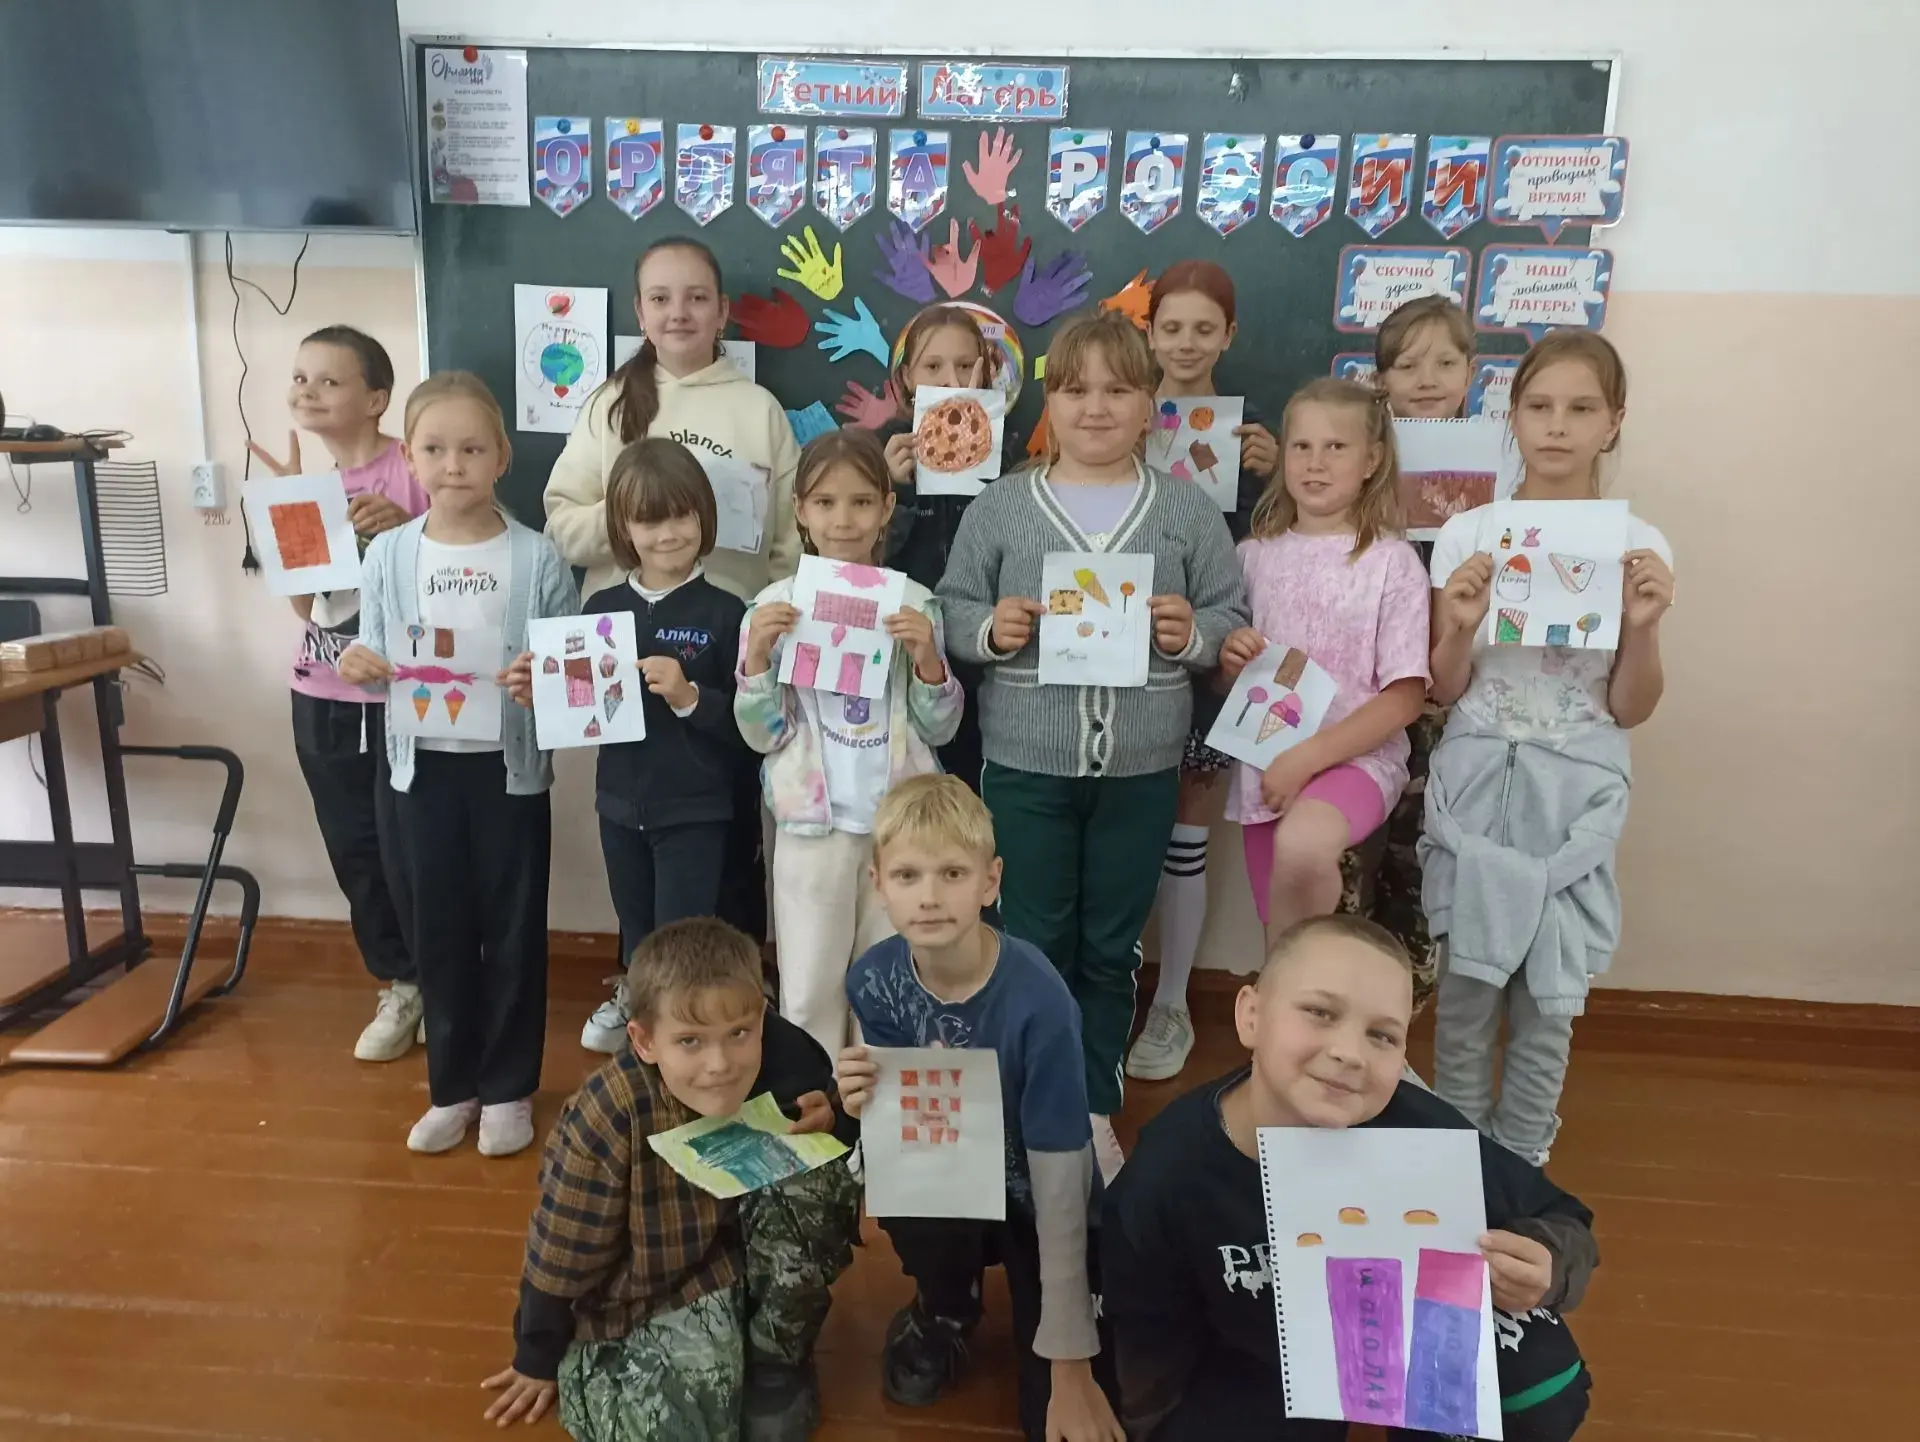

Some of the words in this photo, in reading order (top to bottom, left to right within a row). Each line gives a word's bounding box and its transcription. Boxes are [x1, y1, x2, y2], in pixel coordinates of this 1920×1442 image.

[767, 72, 898, 106] Летний
[928, 66, 1057, 114] Лагерь
[544, 138, 938, 199] ОРЛЯТА
[1521, 155, 1601, 168] ОТЛИЧНО
[1527, 168, 1597, 190] проводим
[1527, 192, 1587, 204] ВРЕМЯ!
[1375, 265, 1435, 277] СКУЧНО
[1525, 264, 1569, 277] НАШ
[1385, 281, 1423, 299] здесь
[1512, 279, 1578, 297] любимый
[1507, 298, 1577, 313] ЛАГЕРЬ!
[655, 627, 709, 644] АЛМАЗ
